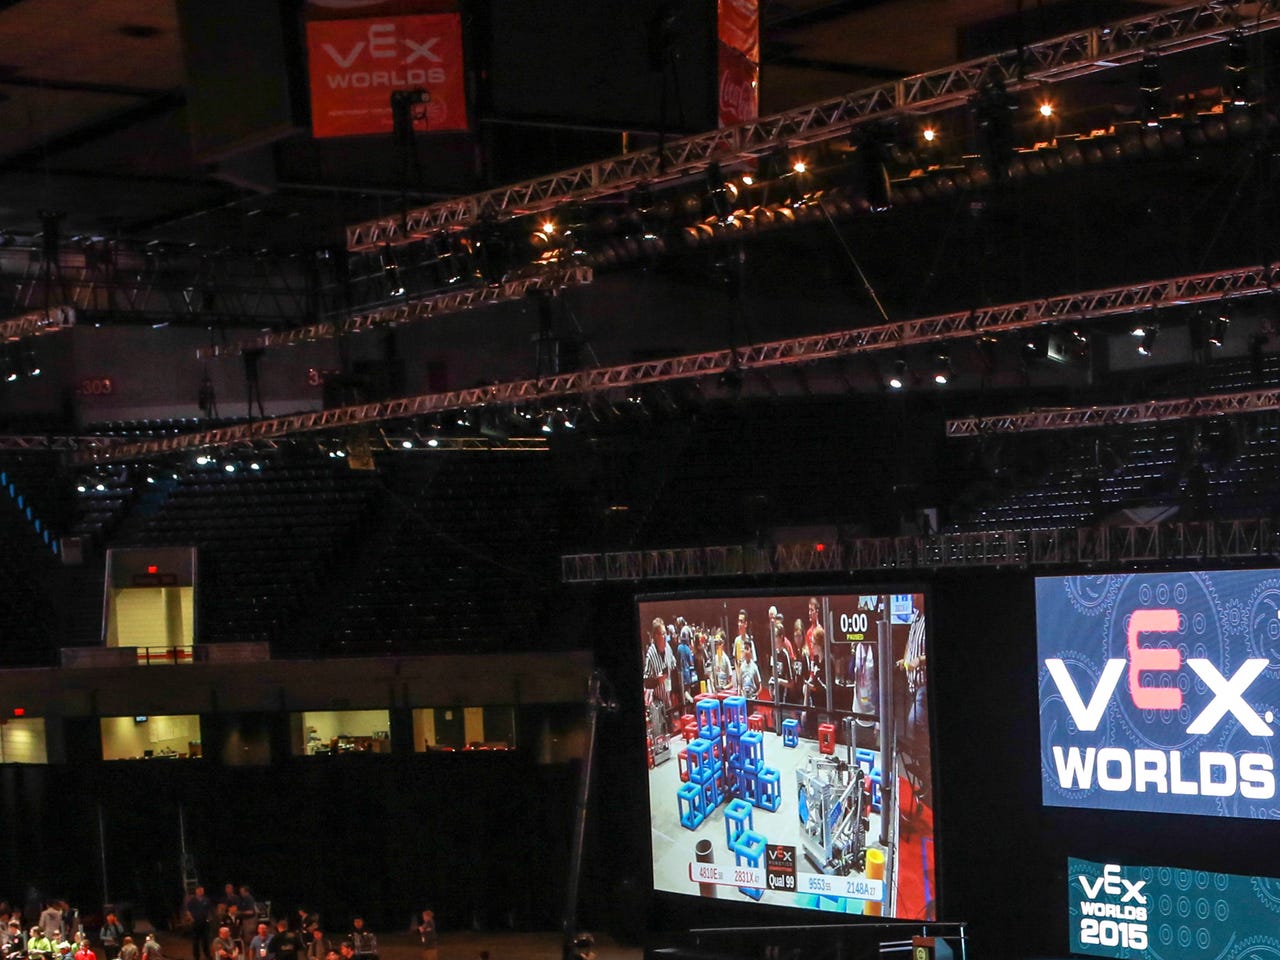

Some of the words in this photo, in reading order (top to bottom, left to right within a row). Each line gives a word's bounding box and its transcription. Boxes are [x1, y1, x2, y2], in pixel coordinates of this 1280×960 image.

[322, 24, 443, 68] VEX
[327, 68, 446, 89] WORLDS
[840, 613, 868, 632] 0:00
[1045, 609, 1274, 736] VEX
[1052, 746, 1276, 799] WORLDS
[769, 846, 792, 861] VEX
[769, 874, 785, 889] Qual
[786, 875, 794, 888] 99
[808, 878, 825, 890] 9553
[846, 881, 869, 895] 2148A
[1078, 864, 1147, 904] VEX
[1080, 901, 1147, 921] WORLDS
[1080, 918, 1148, 950] 2015
